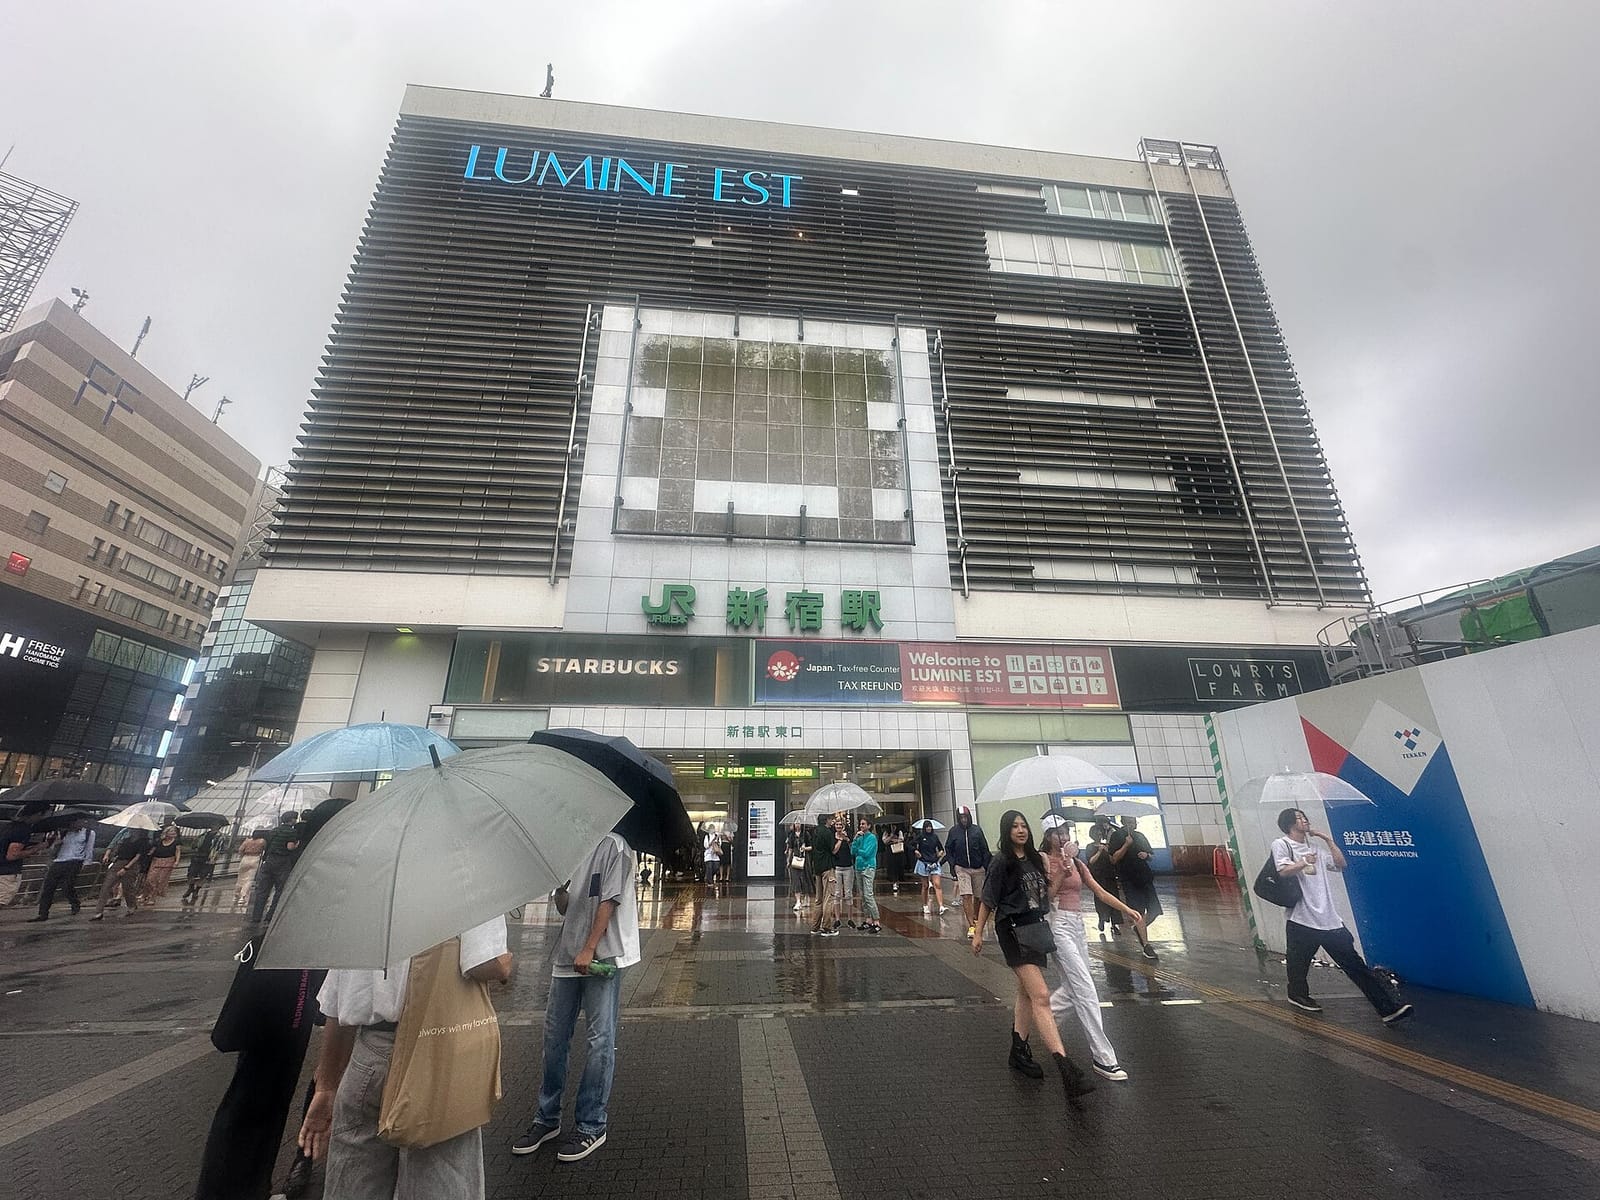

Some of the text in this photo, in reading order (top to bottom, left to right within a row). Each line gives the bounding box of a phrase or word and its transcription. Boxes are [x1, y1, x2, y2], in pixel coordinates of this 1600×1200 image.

[464, 145, 803, 208] LUMINE EST
[642, 584, 884, 631] JR 新宿駅
[25, 649, 61, 662] HANDMADE
[28, 640, 66, 657] FRESH
[23, 655, 60, 669] COSMETICS
[536, 657, 679, 675] STARBUCKS
[908, 652, 1001, 667] Welcome to
[806, 664, 900, 673] Japan. Tax-free Counter
[910, 668, 1002, 683] LUMINE EST
[1195, 663, 1293, 679] LOWRYS
[838, 681, 902, 691] TAX REFUND
[1208, 682, 1289, 697] FARM
[726, 725, 802, 738] 新宿駅東口
[1402, 751, 1427, 760] TEKKEN
[1343, 830, 1415, 847] 鉄建建設
[1372, 850, 1419, 858] CORPORATION
